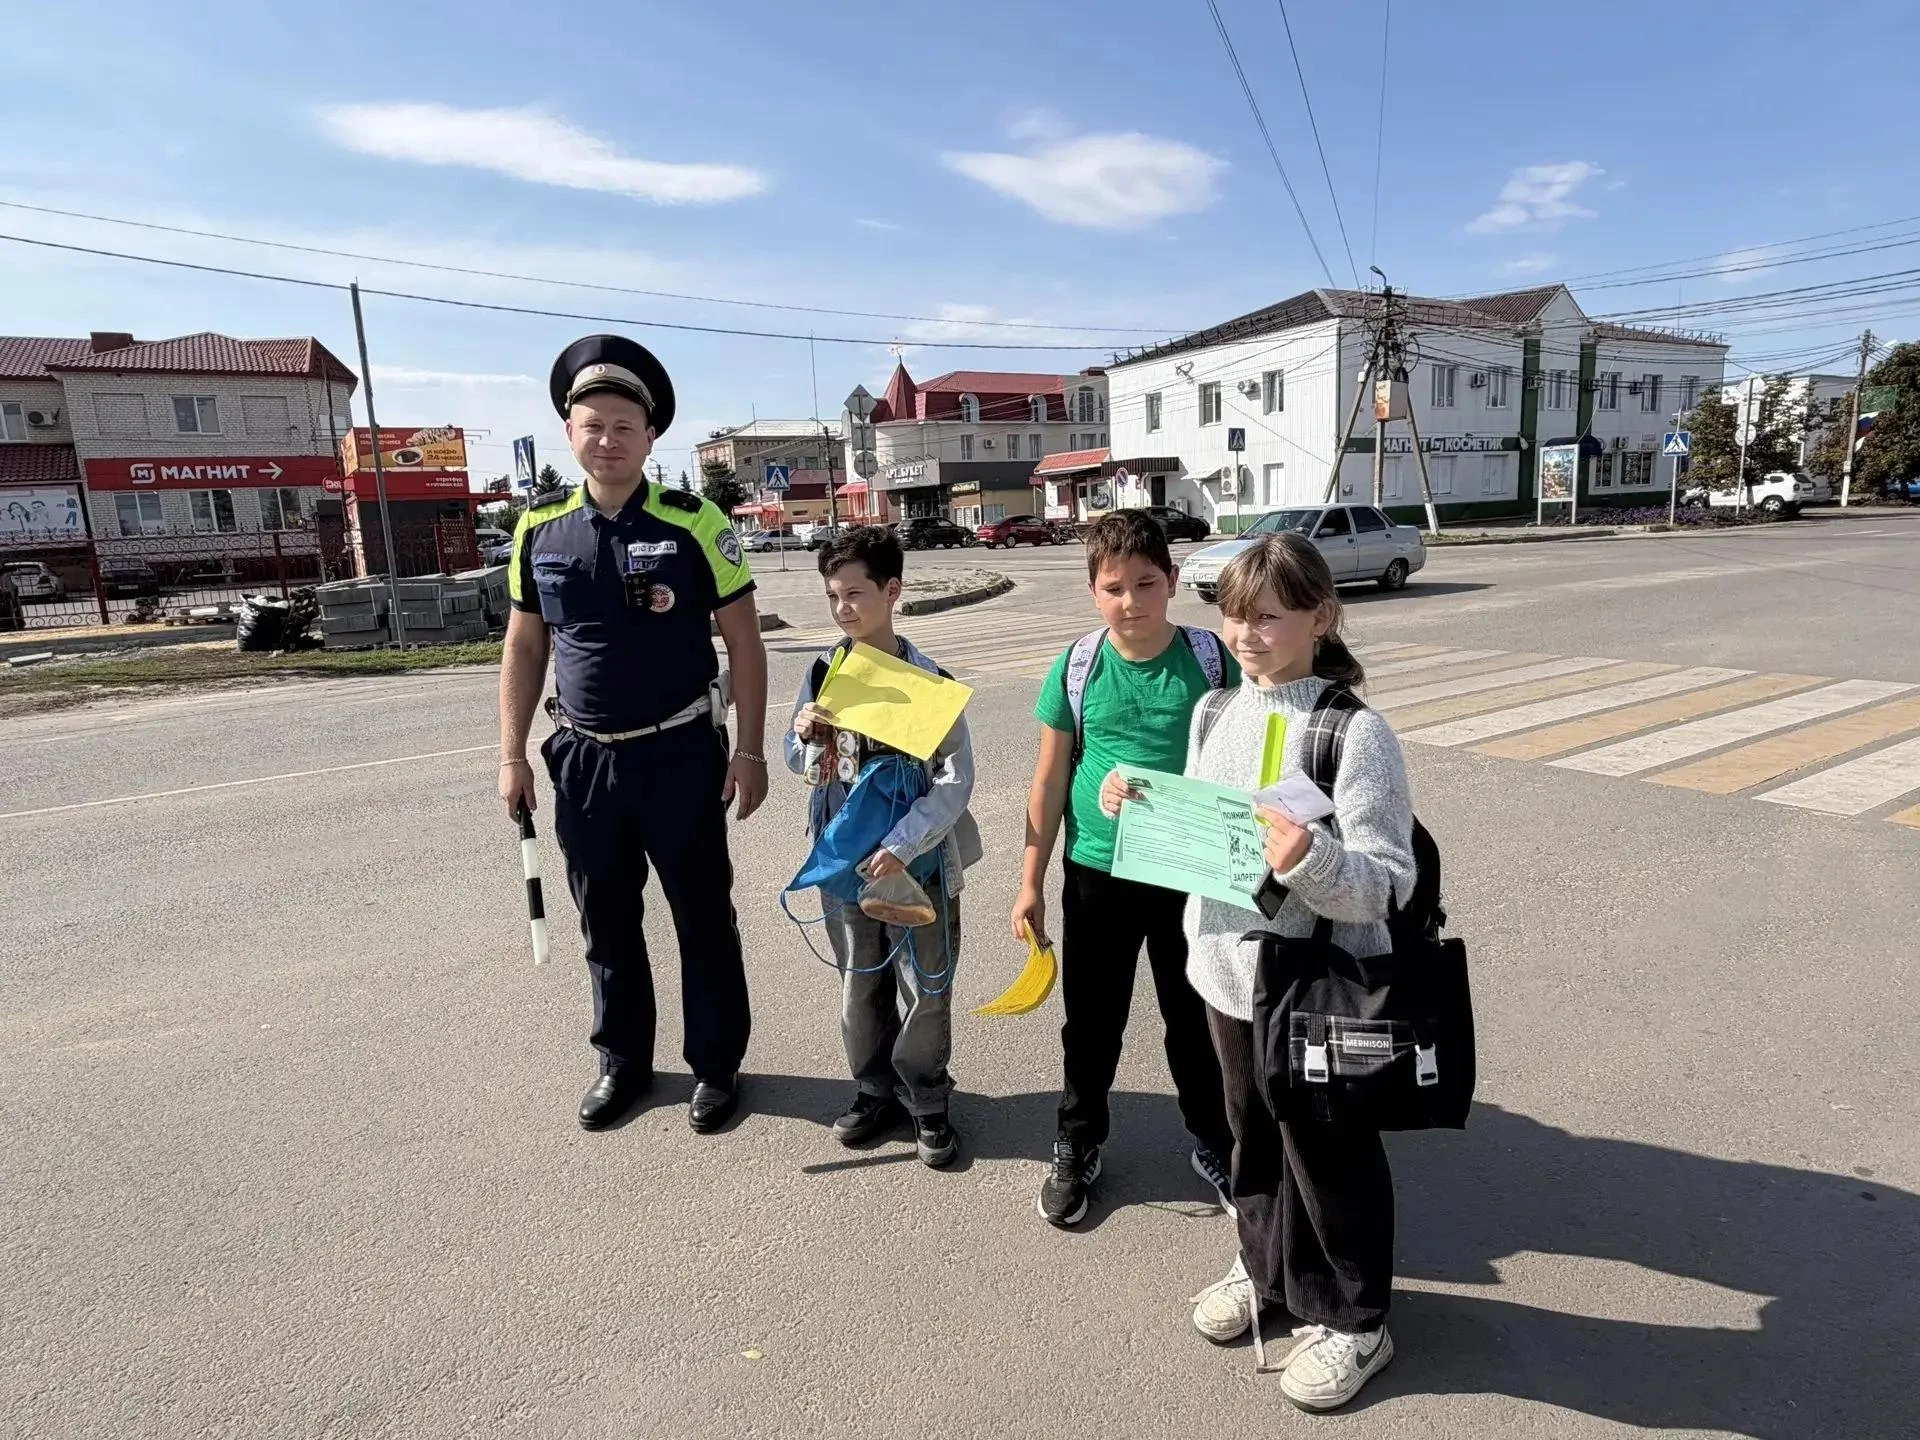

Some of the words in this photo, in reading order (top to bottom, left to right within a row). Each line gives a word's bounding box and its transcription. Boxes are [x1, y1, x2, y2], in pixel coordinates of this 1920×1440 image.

[1383, 437, 1428, 452] МАГНТ
[1444, 437, 1503, 451] КОСМЕТИК
[160, 465, 250, 480] МАГНИТ
[1346, 1039, 1390, 1049] MERNISON
